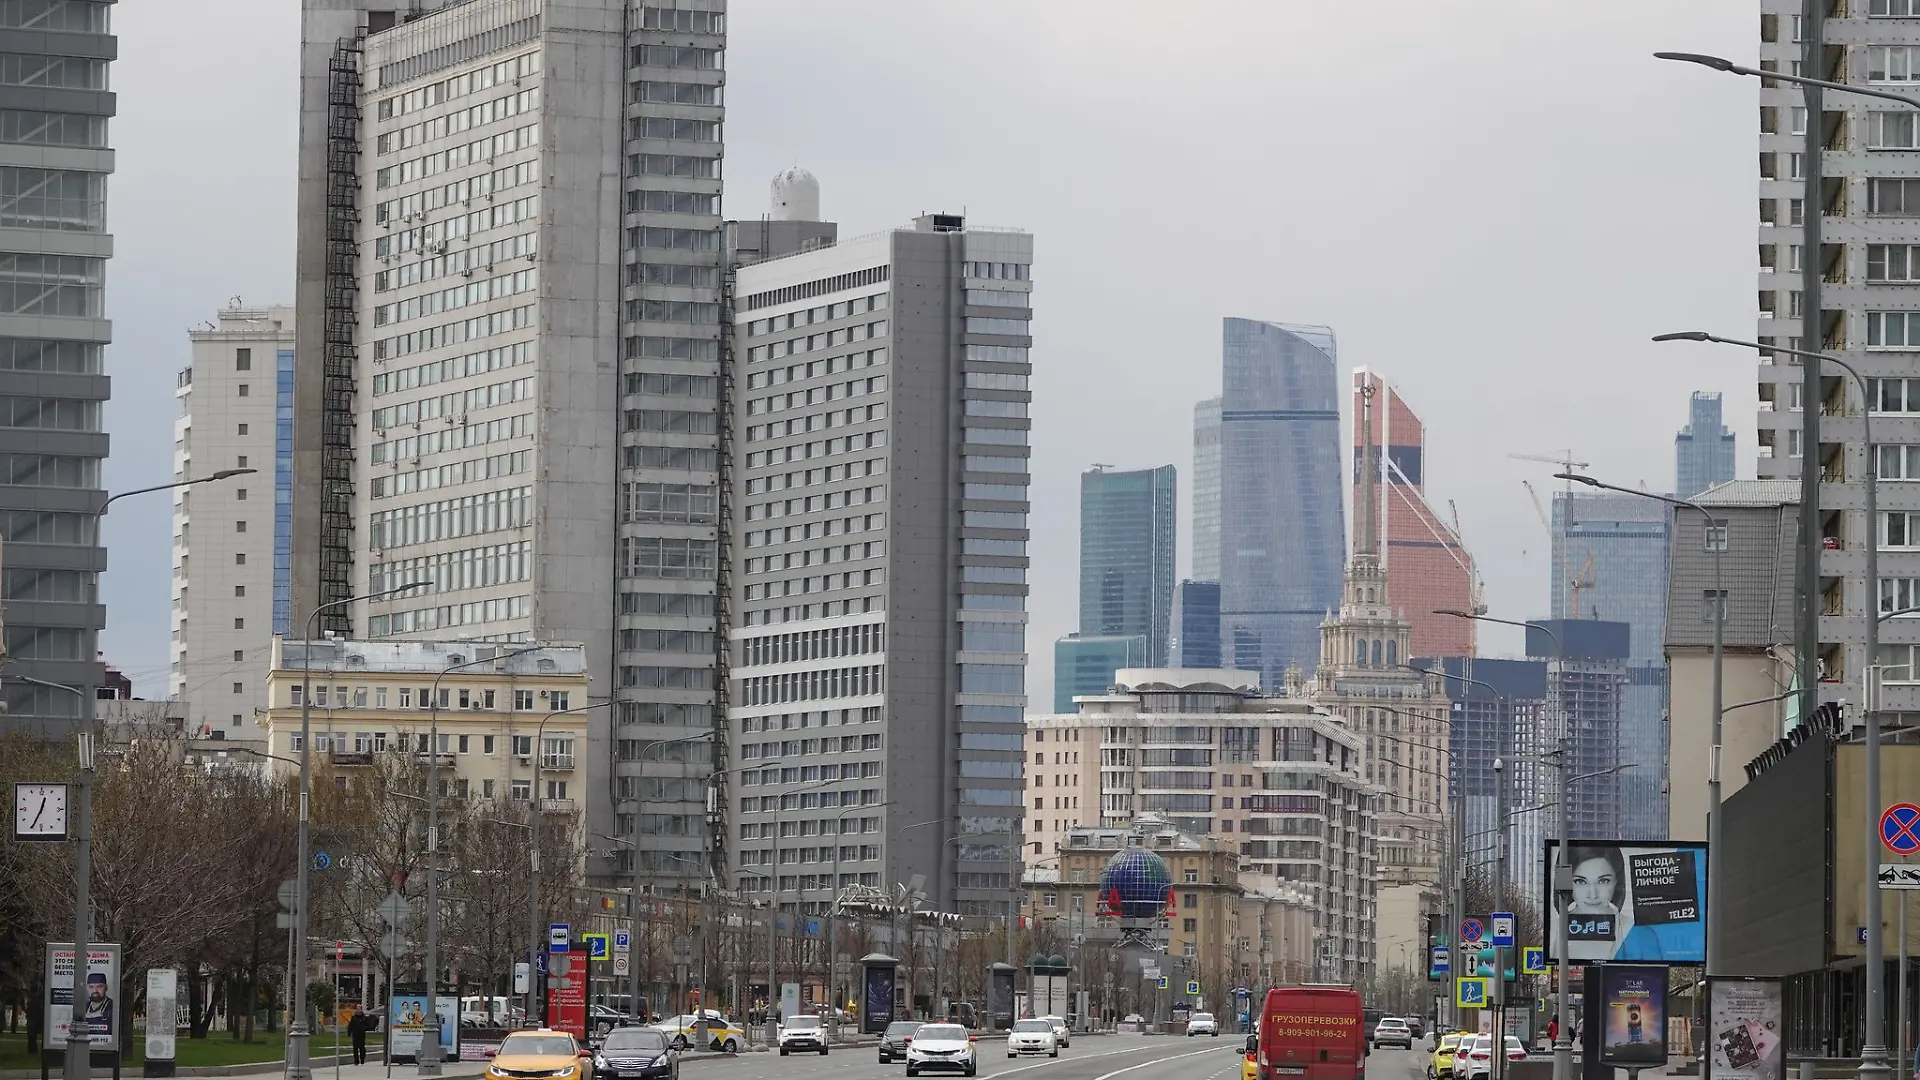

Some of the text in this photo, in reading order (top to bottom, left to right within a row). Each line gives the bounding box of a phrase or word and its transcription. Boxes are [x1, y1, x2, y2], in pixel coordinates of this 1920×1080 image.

[1634, 857, 1675, 868] ВЫГОДА
[1635, 866, 1680, 877] ПОНЯТИЕ
[1636, 876, 1675, 887] ЛИЧНОЕ
[1669, 907, 1695, 919] TELE2
[1272, 1015, 1356, 1026] ГРУЗОПЕРЕВОЗКИ
[1279, 1028, 1347, 1038] 8-909-901-96-24
